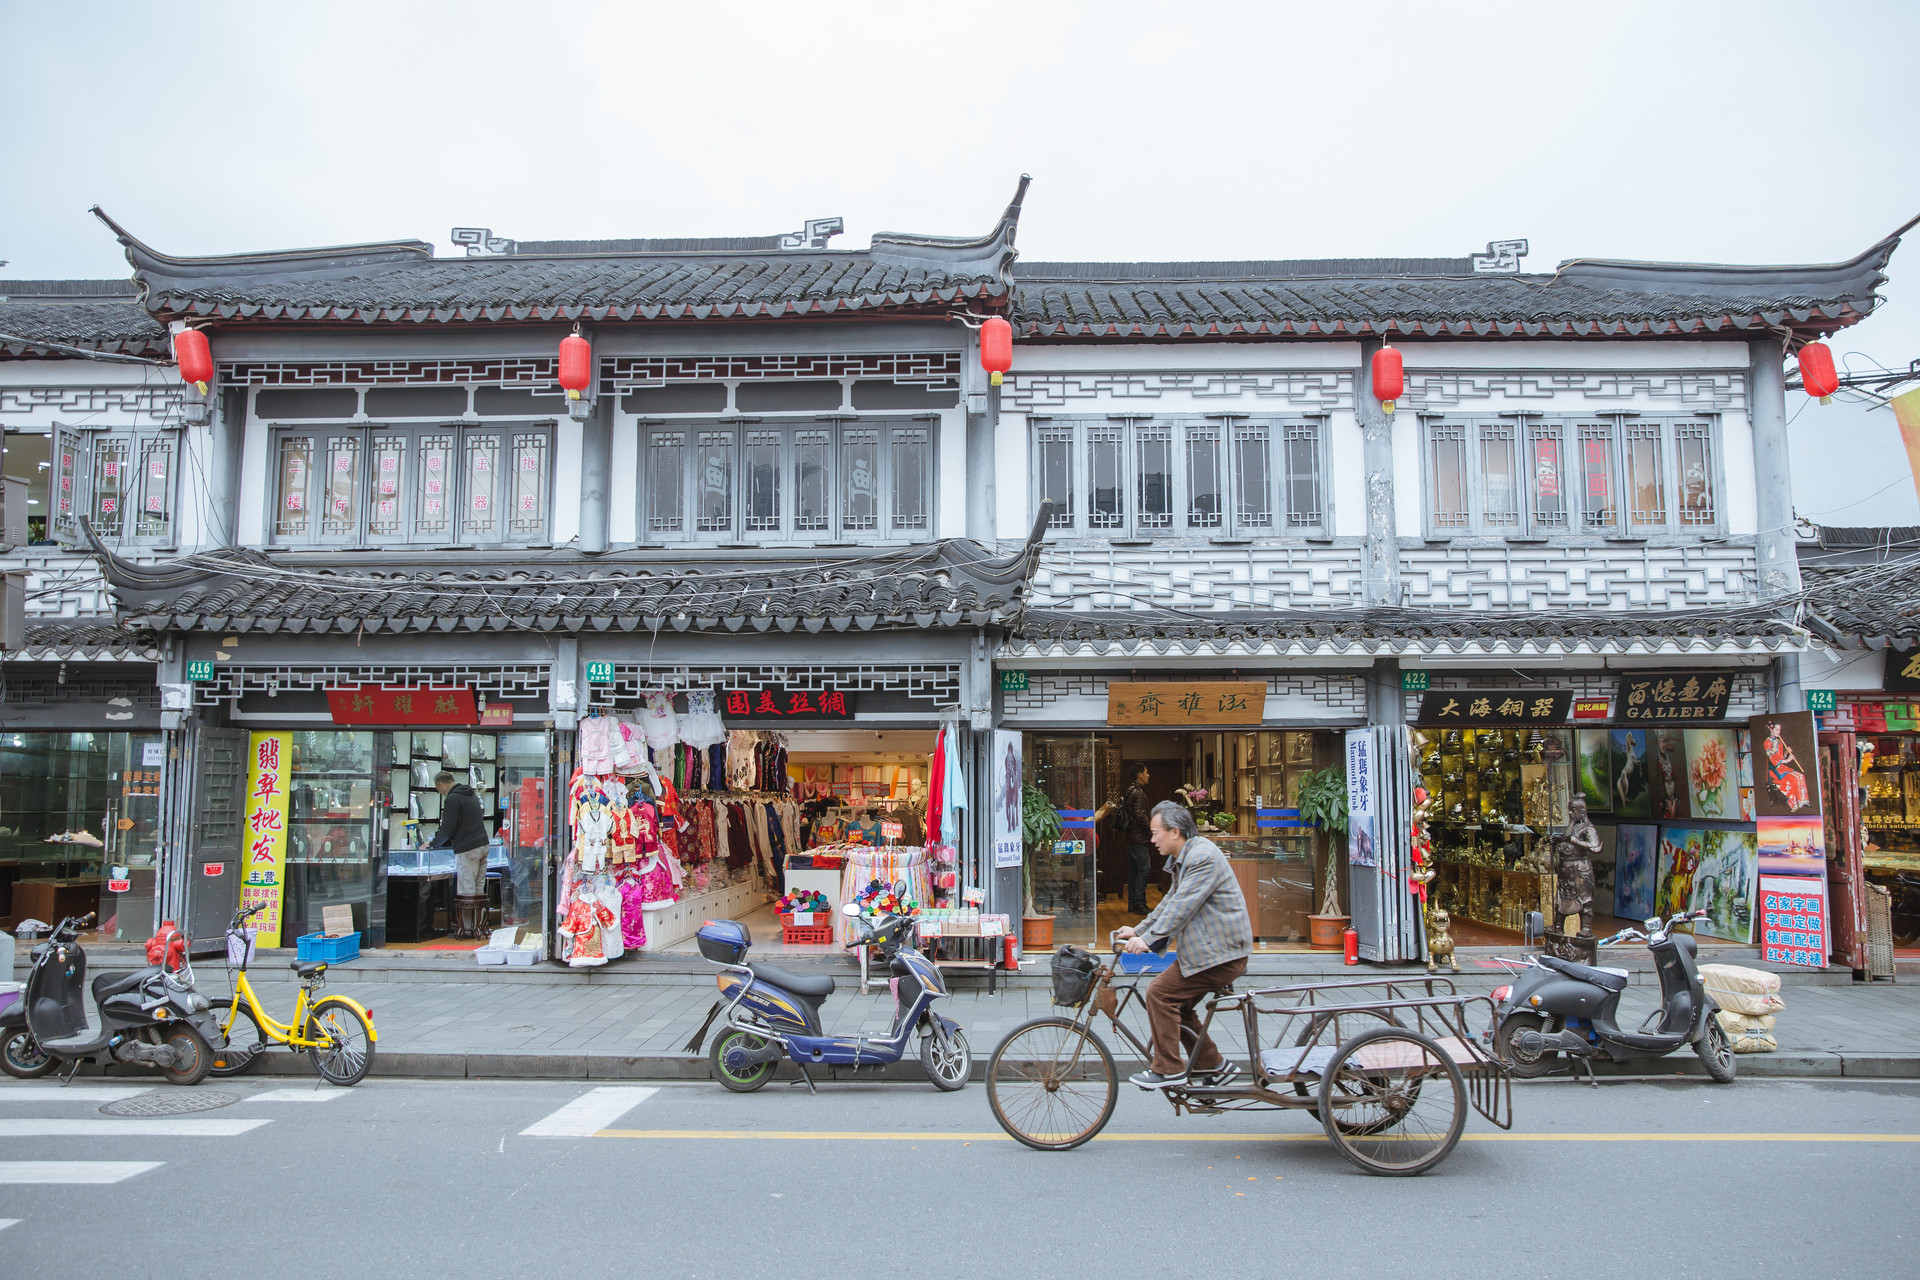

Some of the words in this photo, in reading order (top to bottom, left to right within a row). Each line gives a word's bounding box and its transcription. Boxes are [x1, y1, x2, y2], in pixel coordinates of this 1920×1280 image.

[101, 462, 118, 512] 翡翠
[147, 461, 164, 510] 批发
[288, 460, 303, 509] 二楼
[334, 458, 349, 512] 展厅
[474, 458, 488, 509] 玉器
[521, 457, 536, 510] 批发
[189, 662, 210, 674] 416
[590, 663, 611, 675] 418
[1004, 672, 1025, 684] 420
[1405, 672, 1426, 683] 422
[1811, 692, 1833, 704] 424
[1438, 697, 1555, 718] 大海铜器
[1626, 706, 1719, 719] GALLERY
[1350, 741, 1358, 786] Mammoth
[250, 738, 281, 863] 翡翠批发
[250, 870, 275, 882] 主营
[243, 888, 278, 898] 翡翠摆件
[1765, 895, 1820, 913] 名家字画
[1765, 913, 1821, 931] 字画定做
[1766, 930, 1822, 948] 裱画配框
[1767, 947, 1822, 966] 红木装裱
